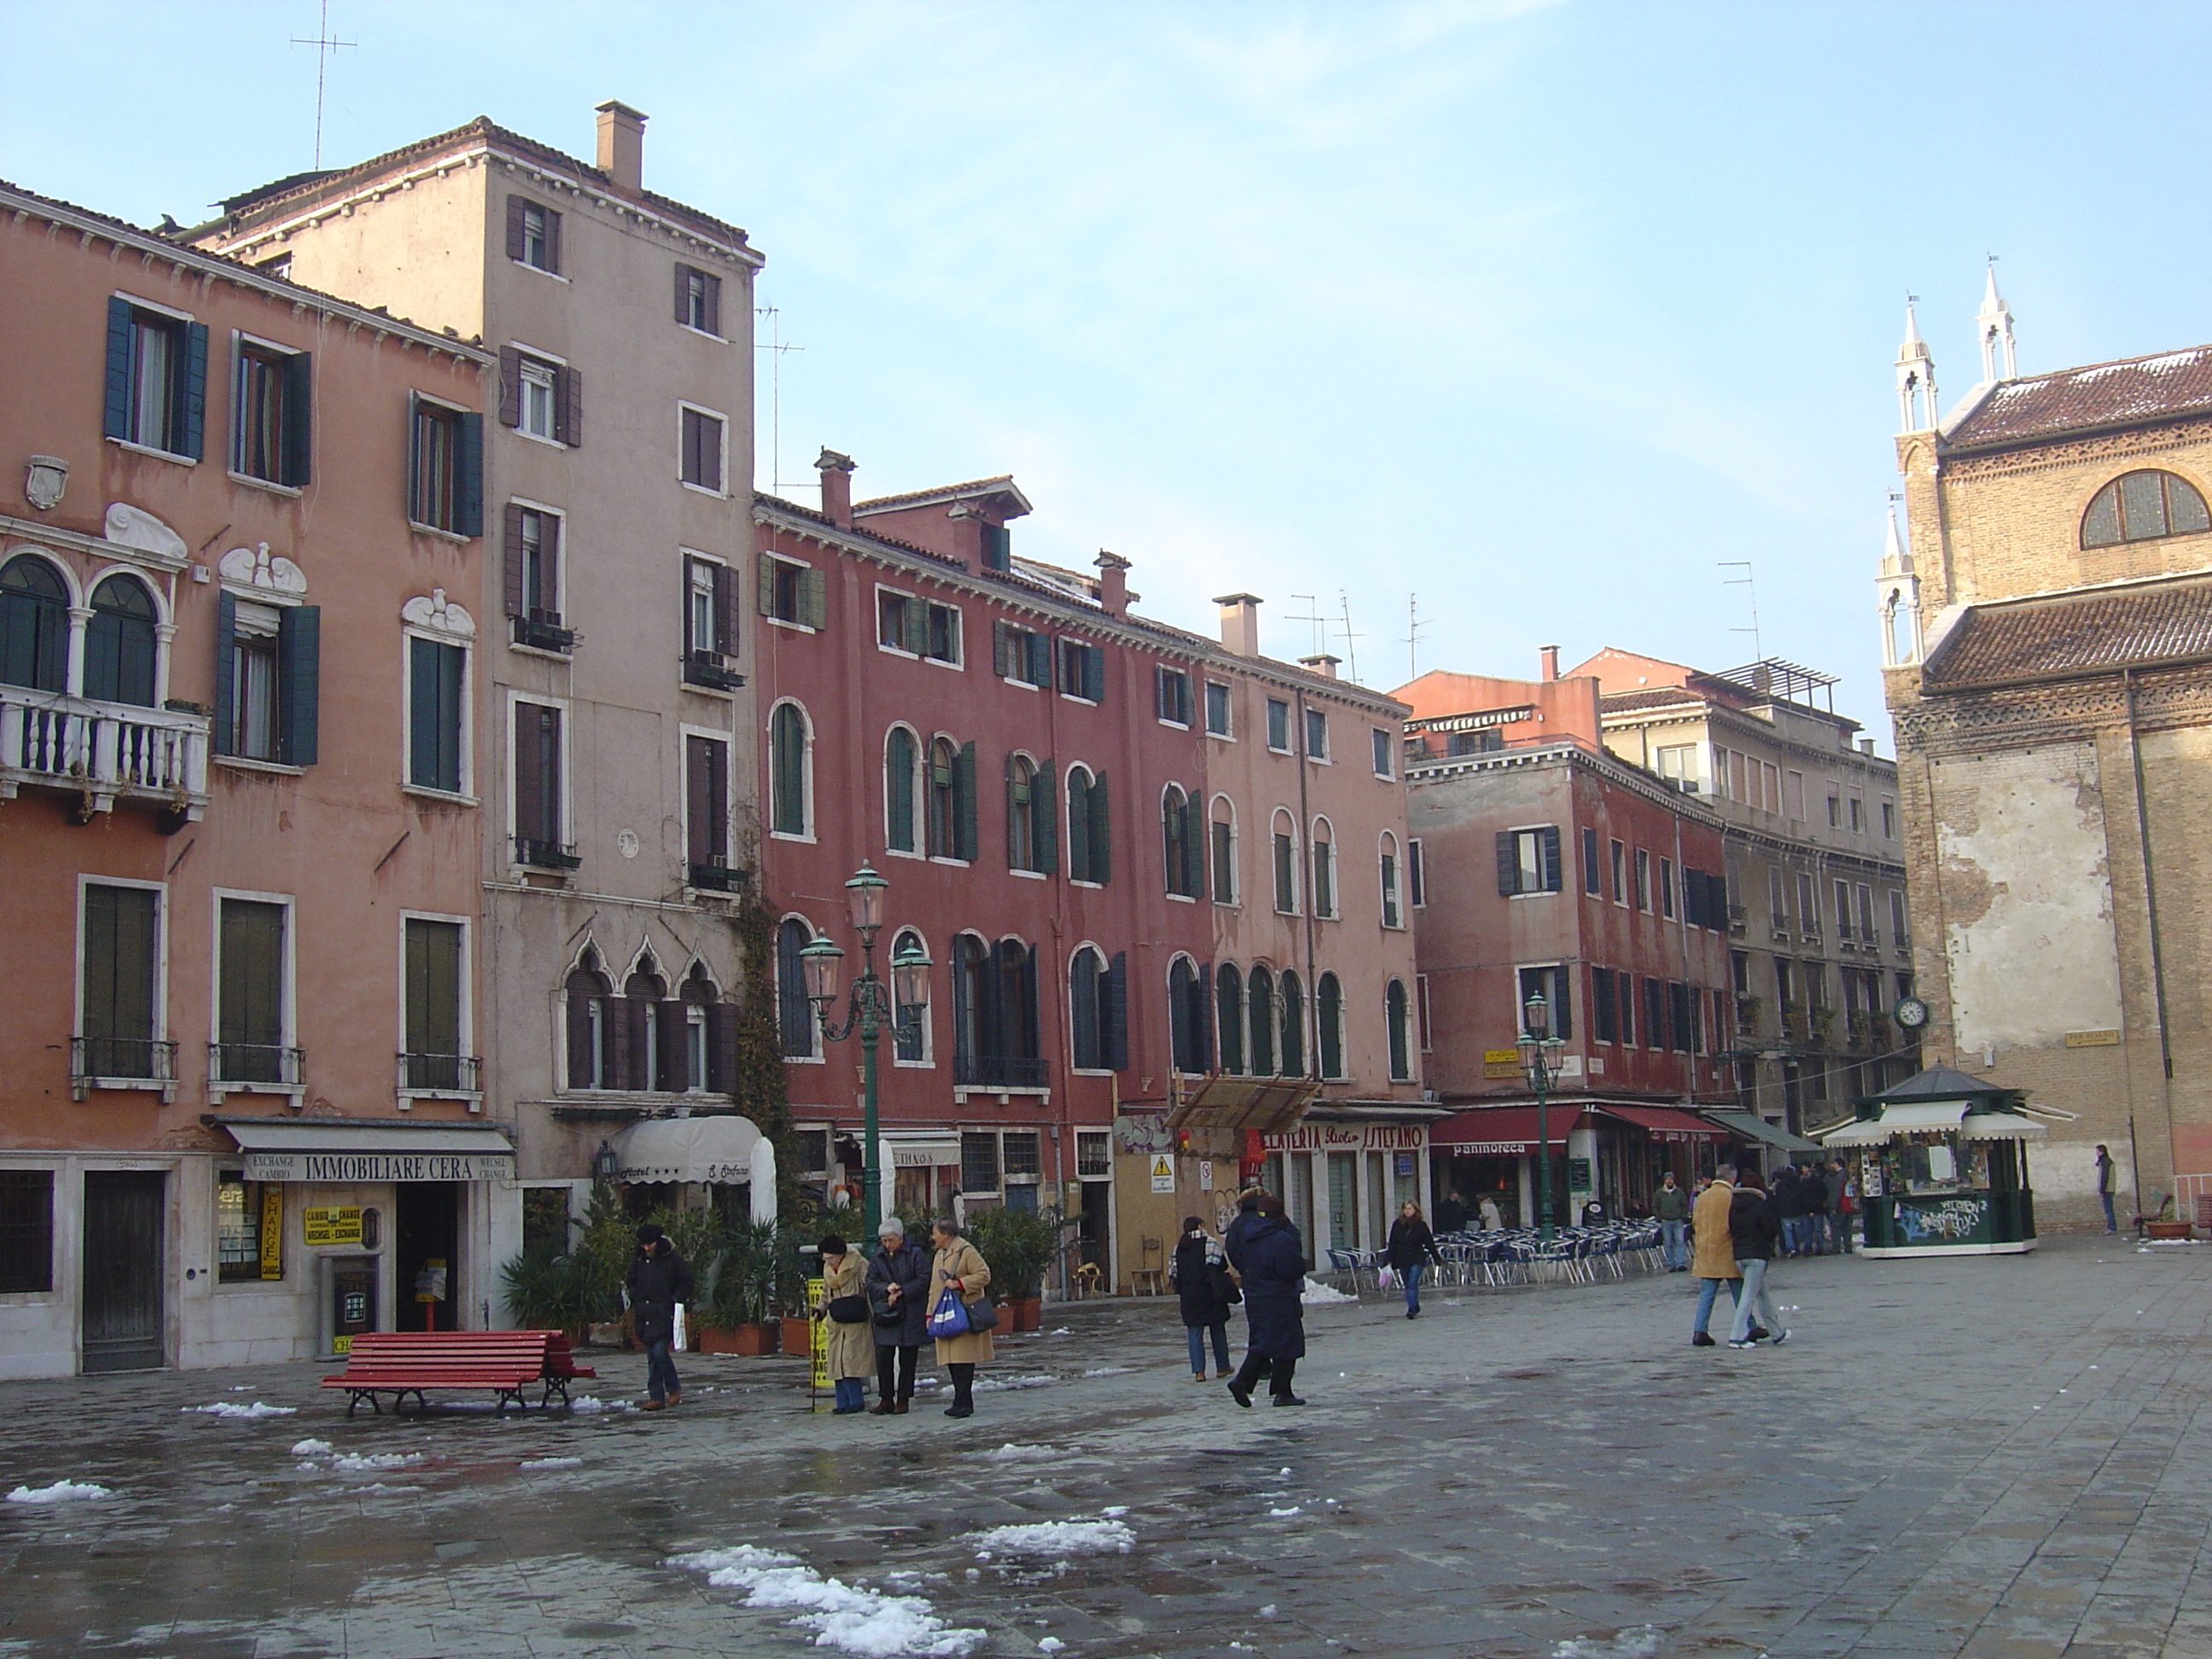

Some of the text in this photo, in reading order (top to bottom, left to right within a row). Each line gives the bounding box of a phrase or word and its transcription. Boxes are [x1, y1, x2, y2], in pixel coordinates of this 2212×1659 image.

[1453, 1144, 1525, 1157] paninoteca
[253, 1155, 294, 1167] EXCHANGE
[306, 1156, 473, 1179] IMMOBILIARE CERA
[620, 1167, 649, 1179] Hotel
[720, 1164, 748, 1179] Stefano
[259, 1169, 290, 1179] CAMBIO
[479, 1169, 507, 1179] CHANGE
[339, 1209, 360, 1220] CHANGE
[266, 1194, 278, 1258] CHANGE
[335, 1229, 360, 1239] EXCHANGE
